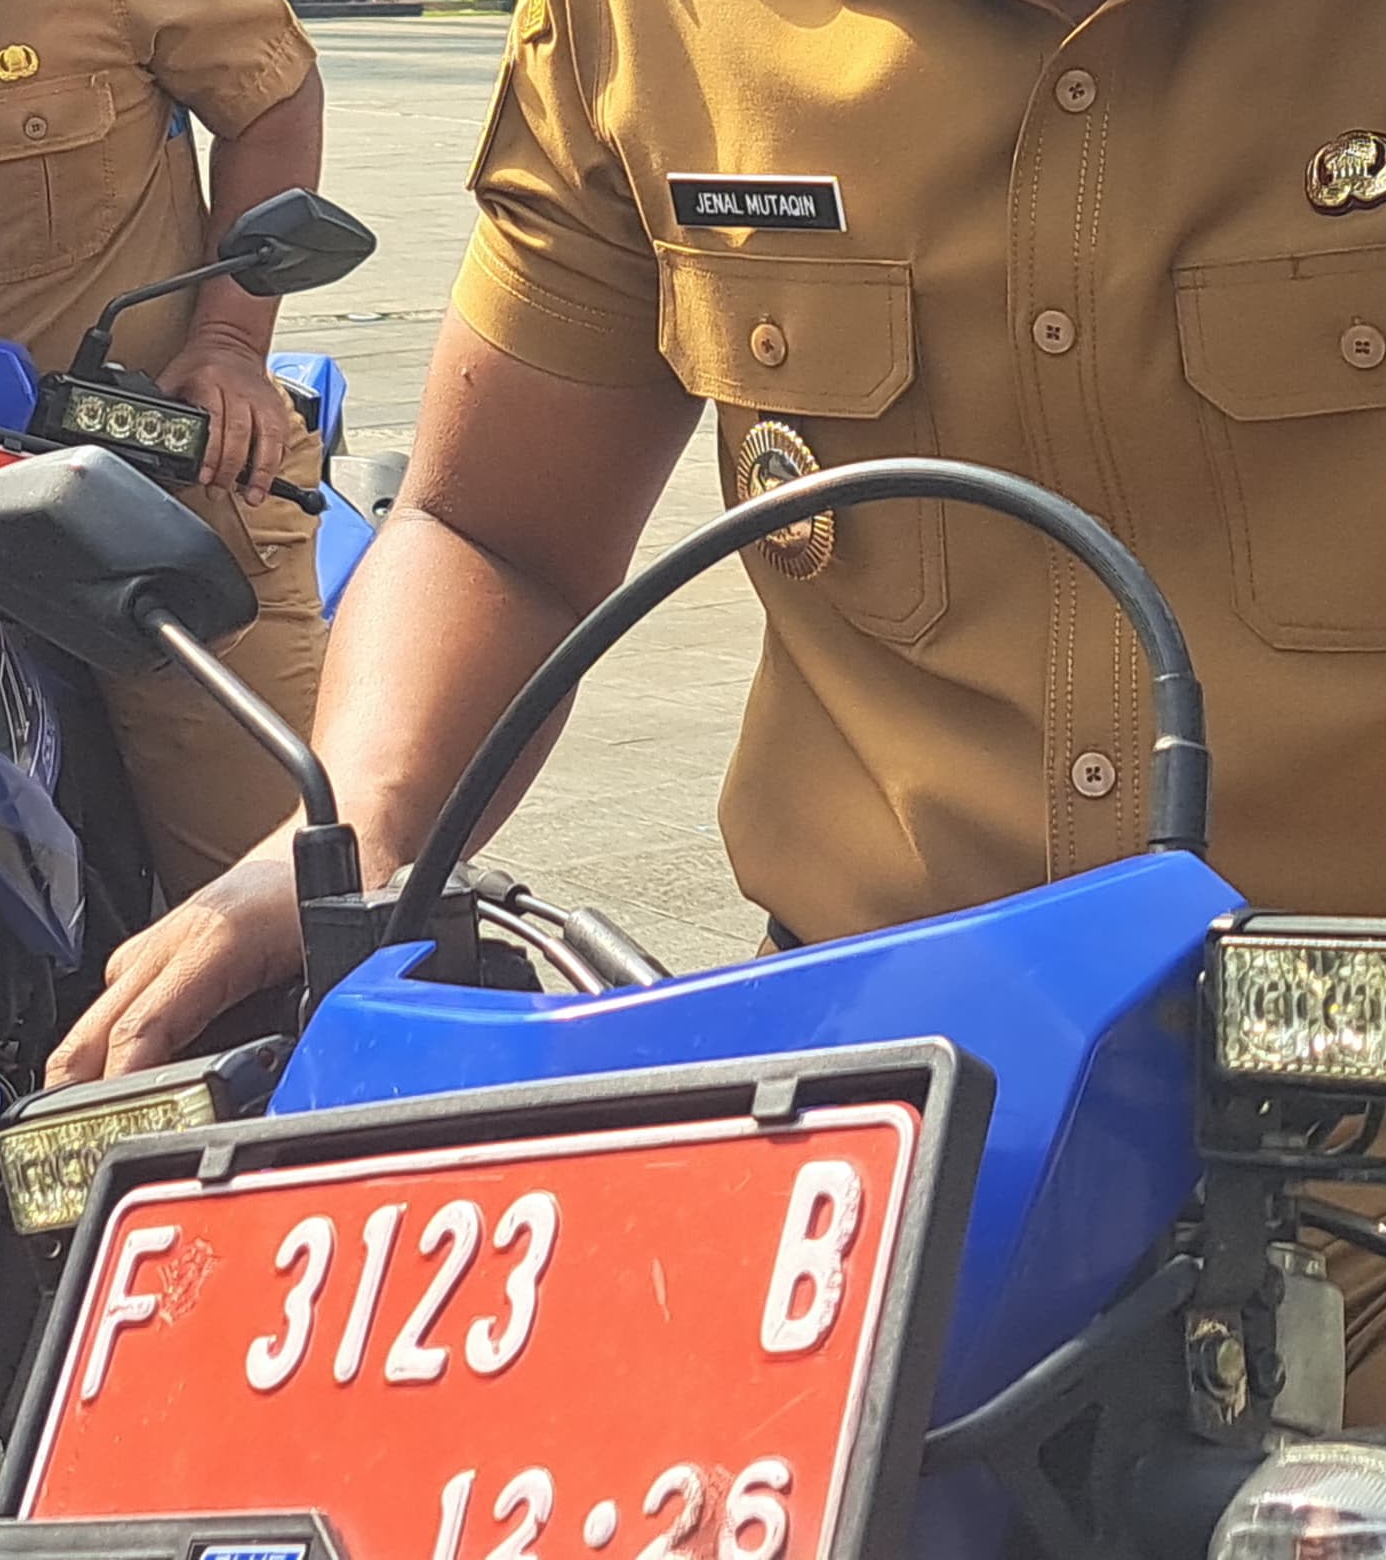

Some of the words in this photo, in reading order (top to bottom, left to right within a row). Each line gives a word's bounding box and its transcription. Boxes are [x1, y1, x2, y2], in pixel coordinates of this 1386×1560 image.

[696, 193, 744, 215] JENAL
[745, 194, 817, 218] MUTAQIN
[80, 1224, 182, 1403] F
[245, 1190, 563, 1393] 3123
[761, 1158, 865, 1354] B
